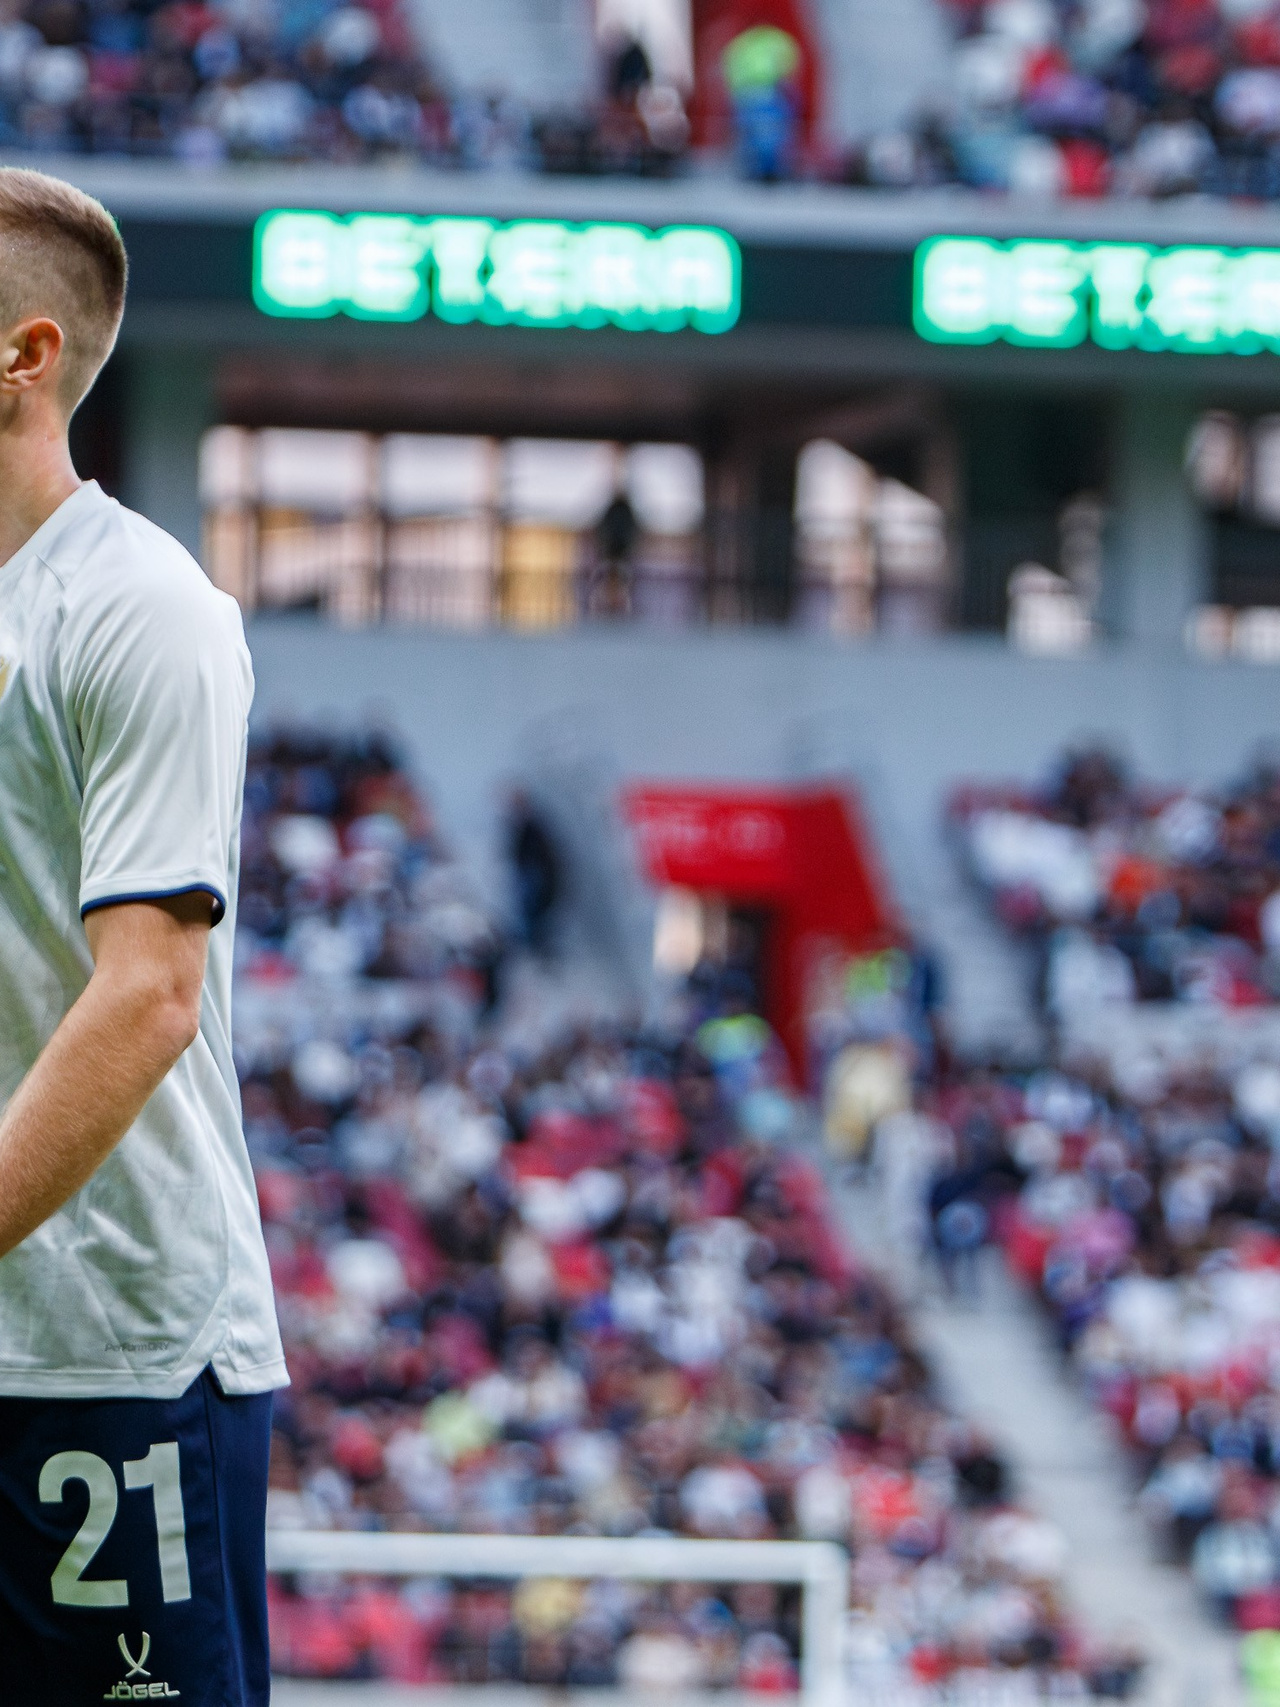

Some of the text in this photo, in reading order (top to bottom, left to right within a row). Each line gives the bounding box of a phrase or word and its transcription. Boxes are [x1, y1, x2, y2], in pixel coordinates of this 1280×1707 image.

[252, 208, 742, 334] BETERA
[38, 1441, 191, 1607] 21
[103, 1681, 181, 1700] JÖGEL
